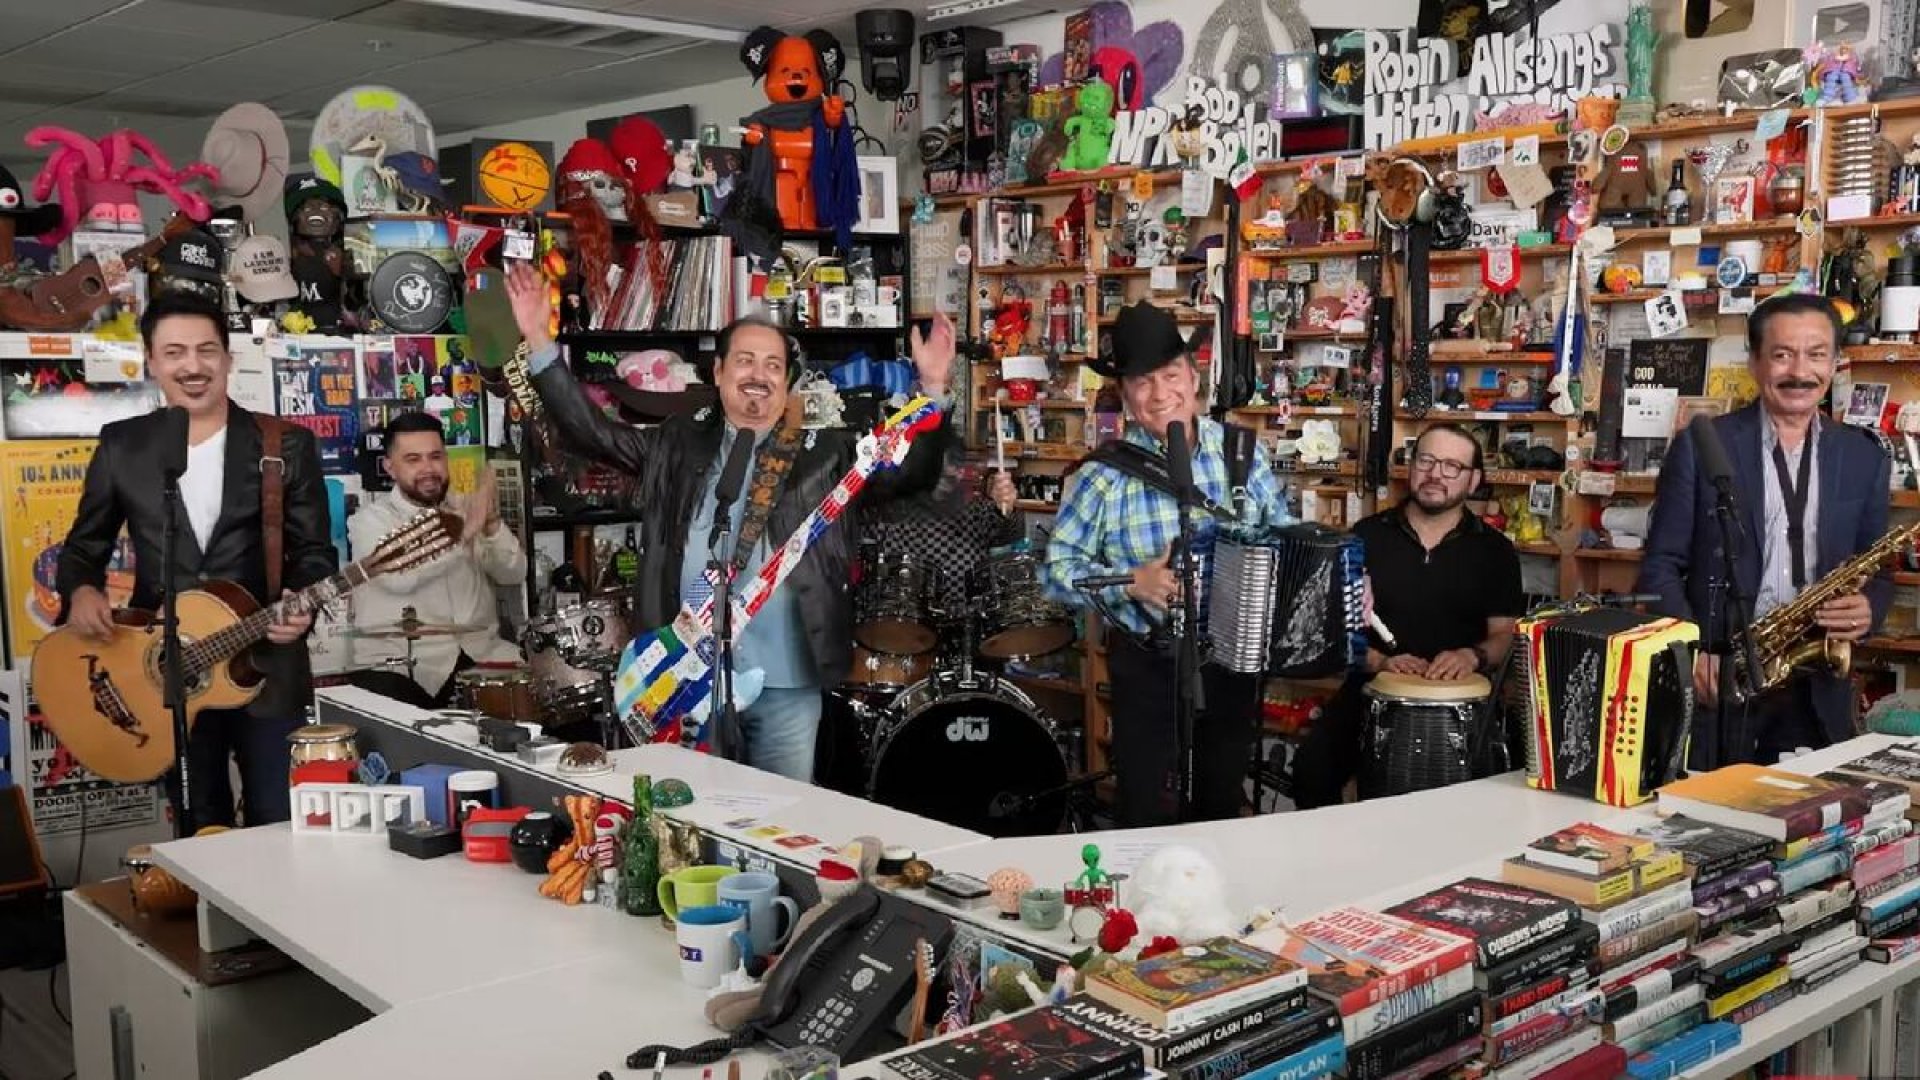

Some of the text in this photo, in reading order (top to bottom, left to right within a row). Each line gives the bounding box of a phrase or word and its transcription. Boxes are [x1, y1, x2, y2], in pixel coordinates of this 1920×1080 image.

[1365, 29, 1449, 95] Robin
[1469, 24, 1611, 97] Allsongs
[1187, 72, 1240, 124] Bob
[1365, 86, 1468, 150] Hilton
[946, 716, 990, 741] dw
[1167, 1031, 1212, 1061] JOHNNY
[1213, 1019, 1241, 1042] CASH
[1242, 1012, 1263, 1032] FAQ
[1279, 1054, 1327, 1080] DYLAN
